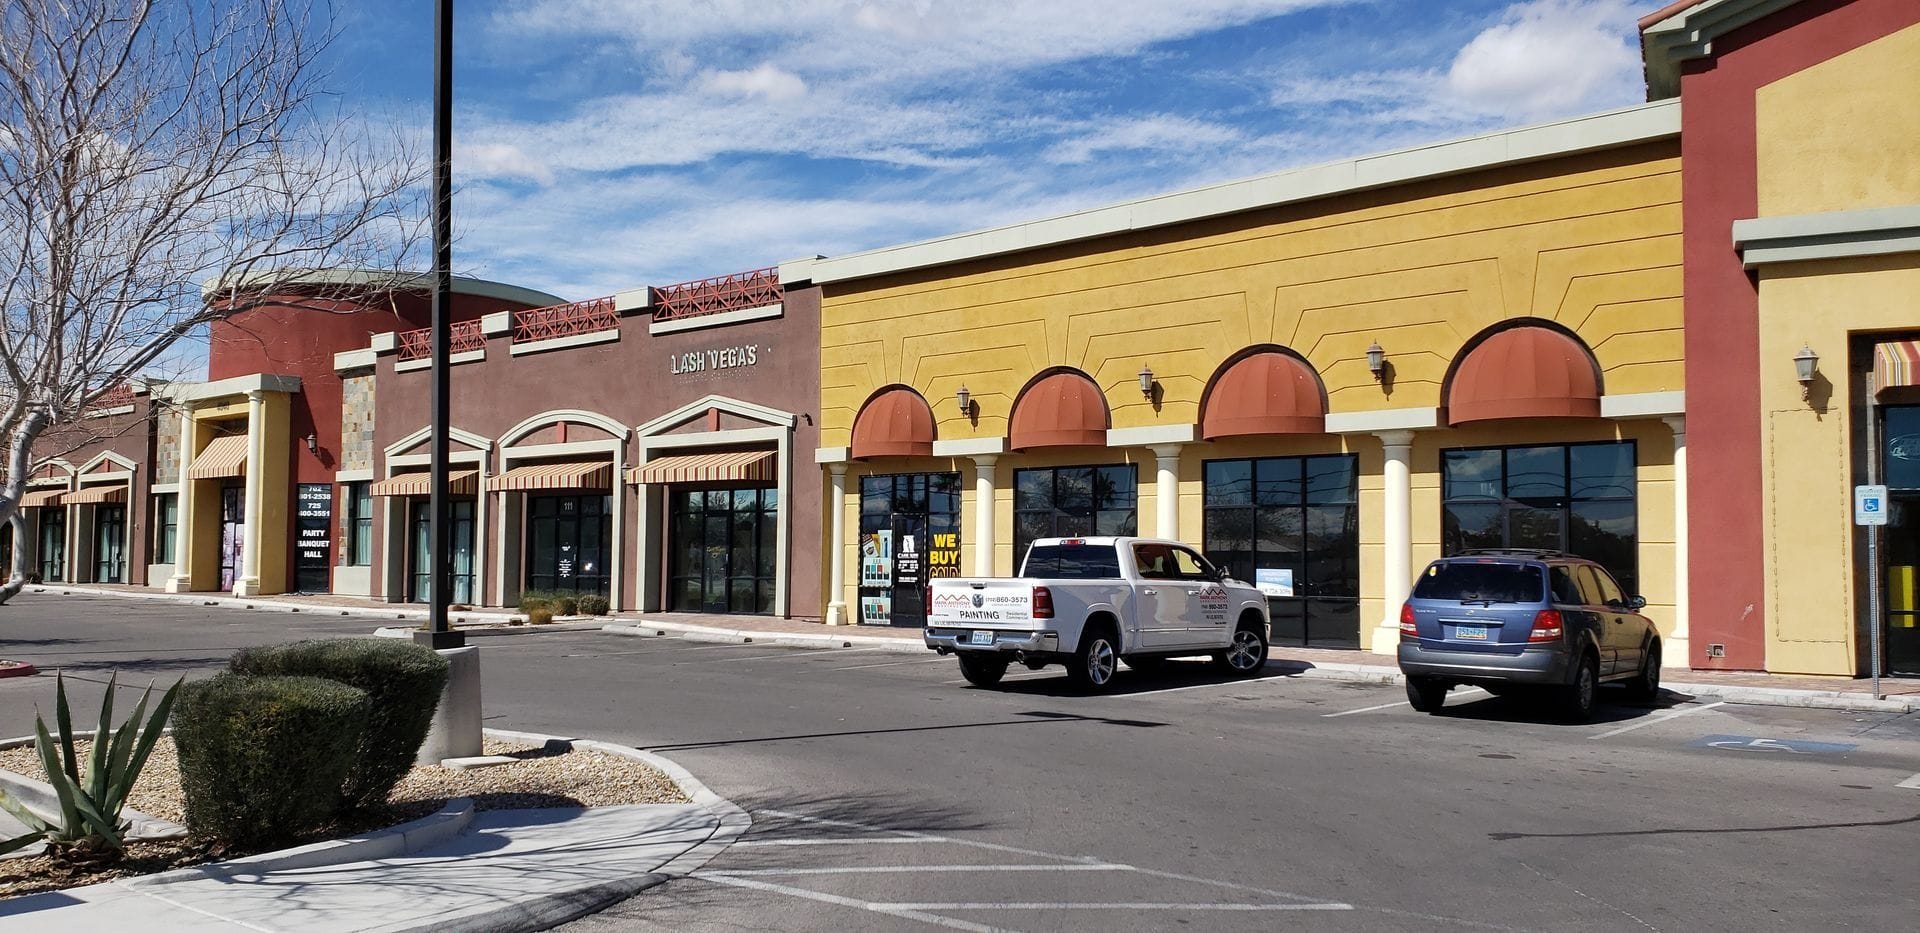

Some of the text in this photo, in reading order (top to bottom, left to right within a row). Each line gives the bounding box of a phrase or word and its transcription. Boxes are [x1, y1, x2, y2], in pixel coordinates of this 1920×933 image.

[671, 346, 757, 375] LASH VEGAS
[302, 529, 326, 537] PARTY
[297, 540, 330, 548] BANQUET
[933, 533, 957, 548] WE
[304, 550, 323, 558] HALL
[929, 550, 959, 565] BUY
[959, 610, 1000, 620] PAINTING
